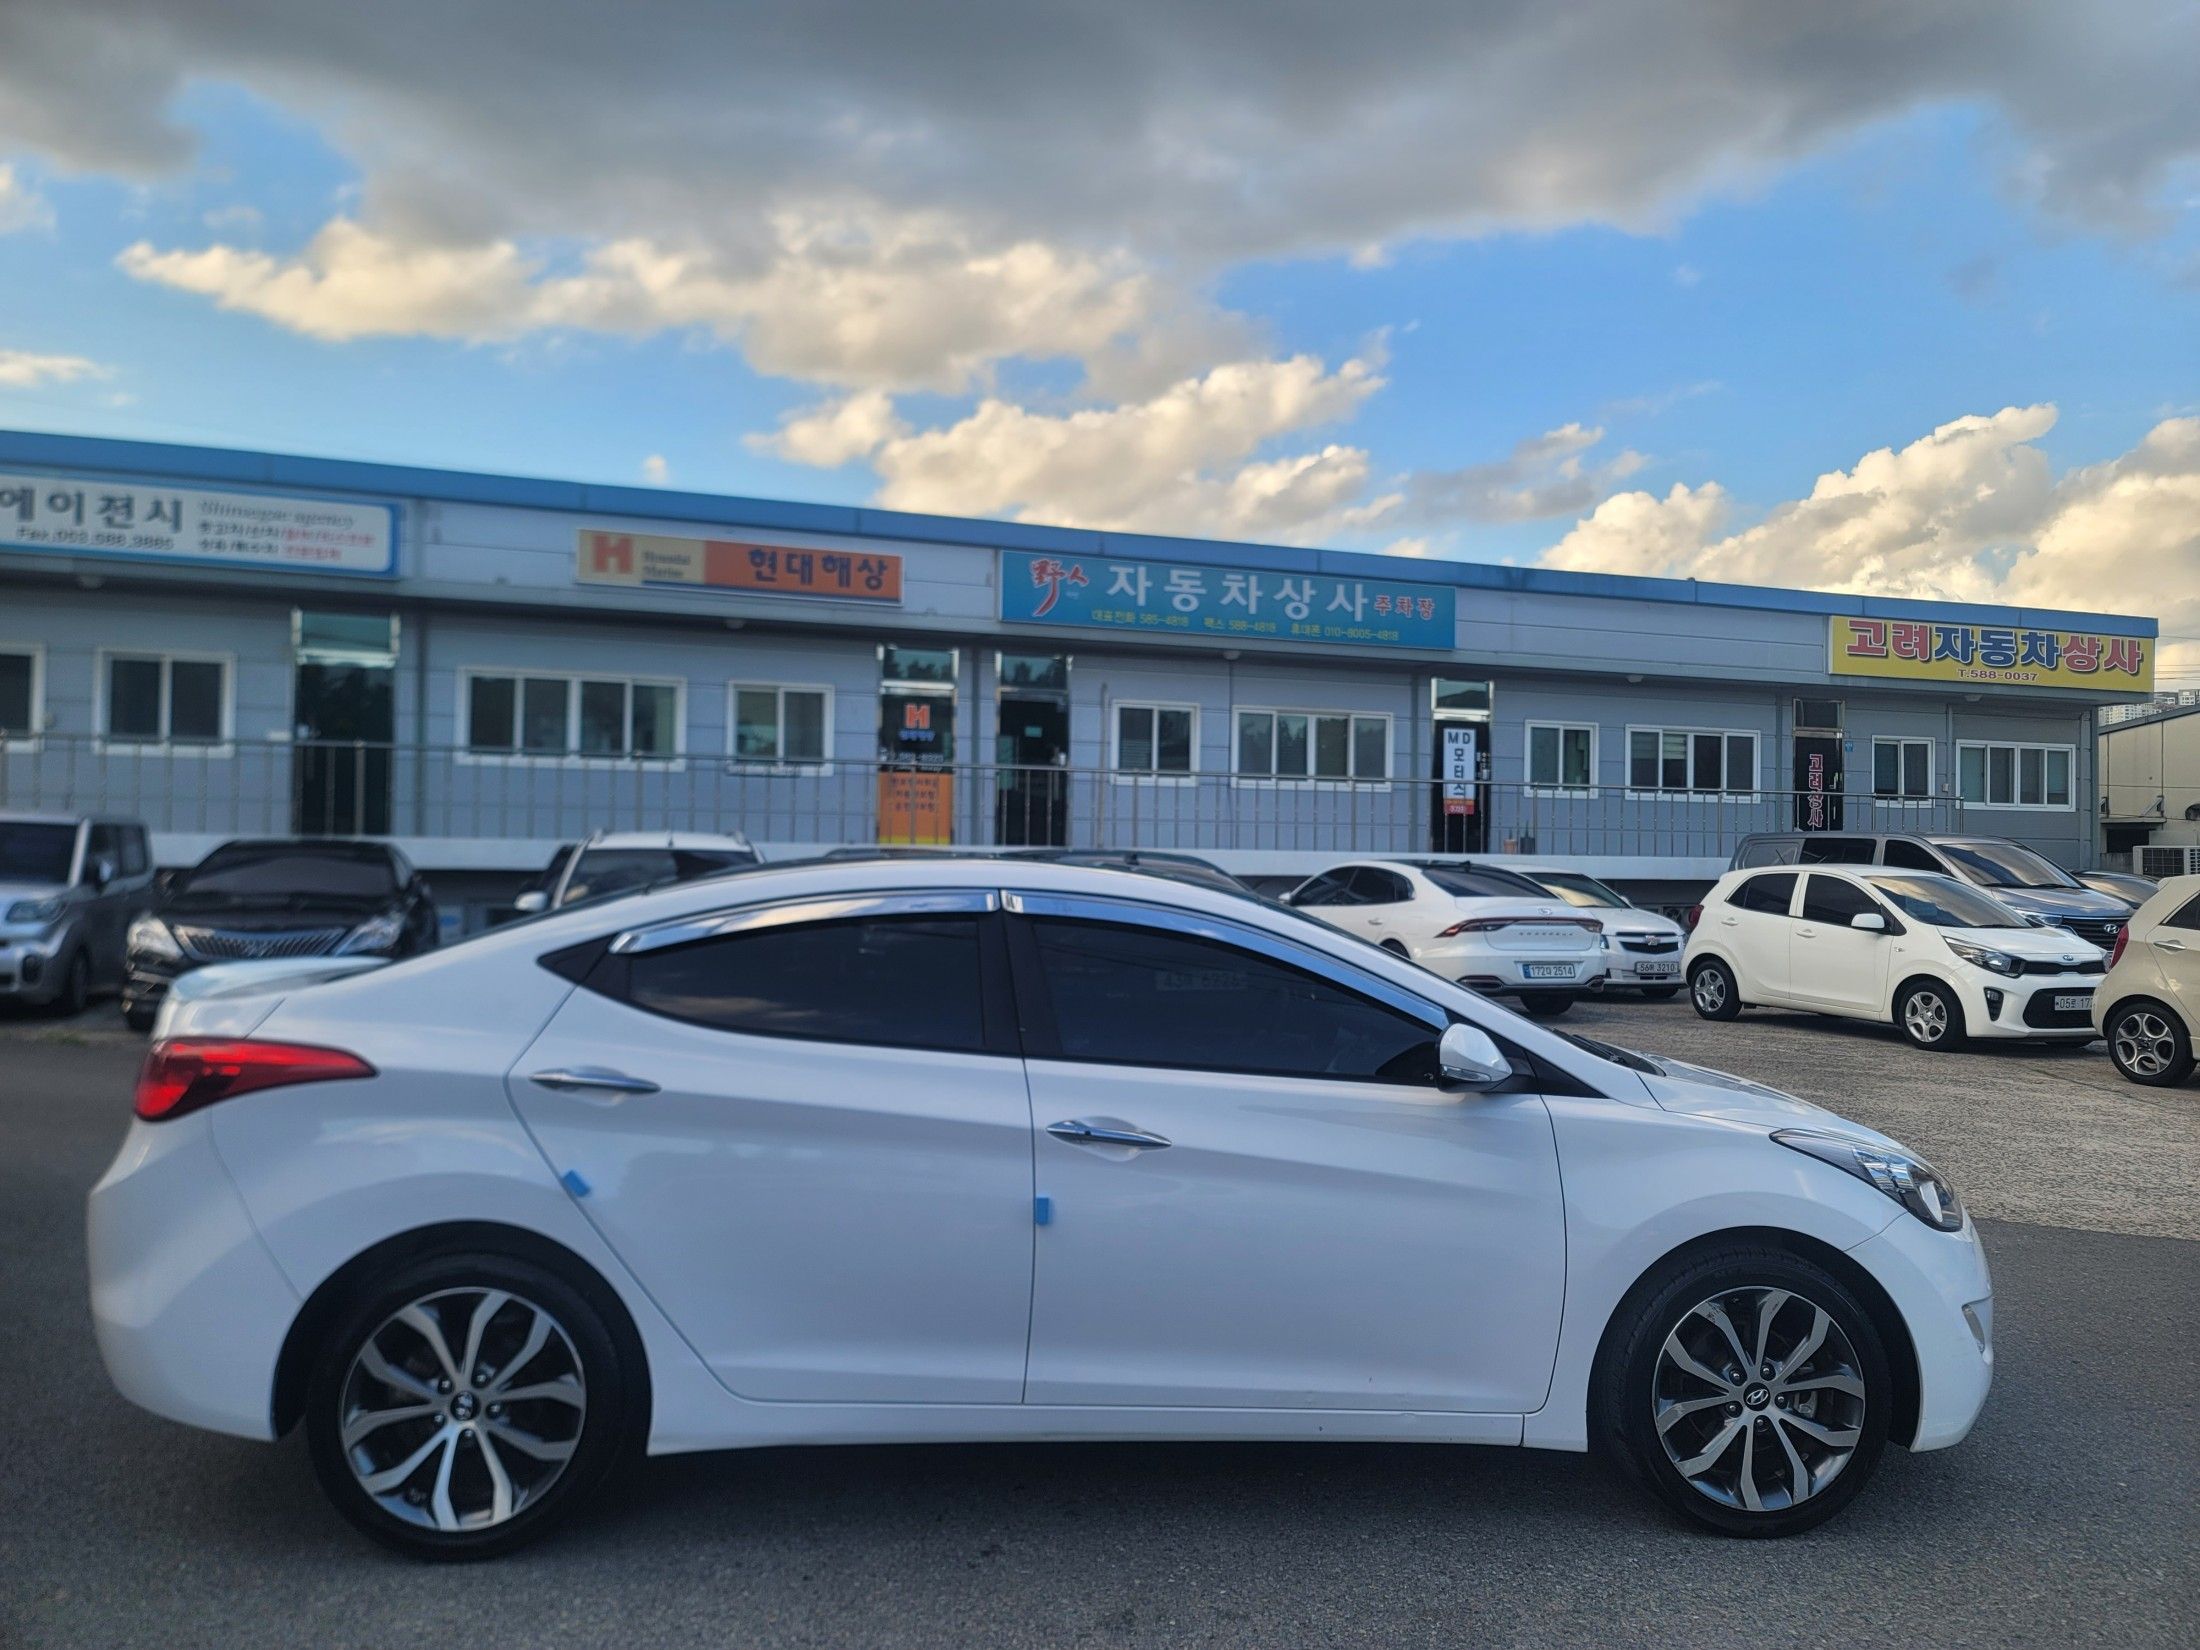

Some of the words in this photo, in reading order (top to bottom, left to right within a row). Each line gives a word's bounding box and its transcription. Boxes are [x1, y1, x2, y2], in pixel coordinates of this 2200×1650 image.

[748, 548, 888, 592] 현대해상
[1106, 563, 1369, 623] 자동차상사
[1374, 594, 1436, 620] 주차장
[1846, 618, 2144, 675] 고려자동차상사
[1957, 668, 2039, 682] T.588-0037
[1553, 966, 1573, 976] 2514
[1656, 963, 1675, 972] 3210
